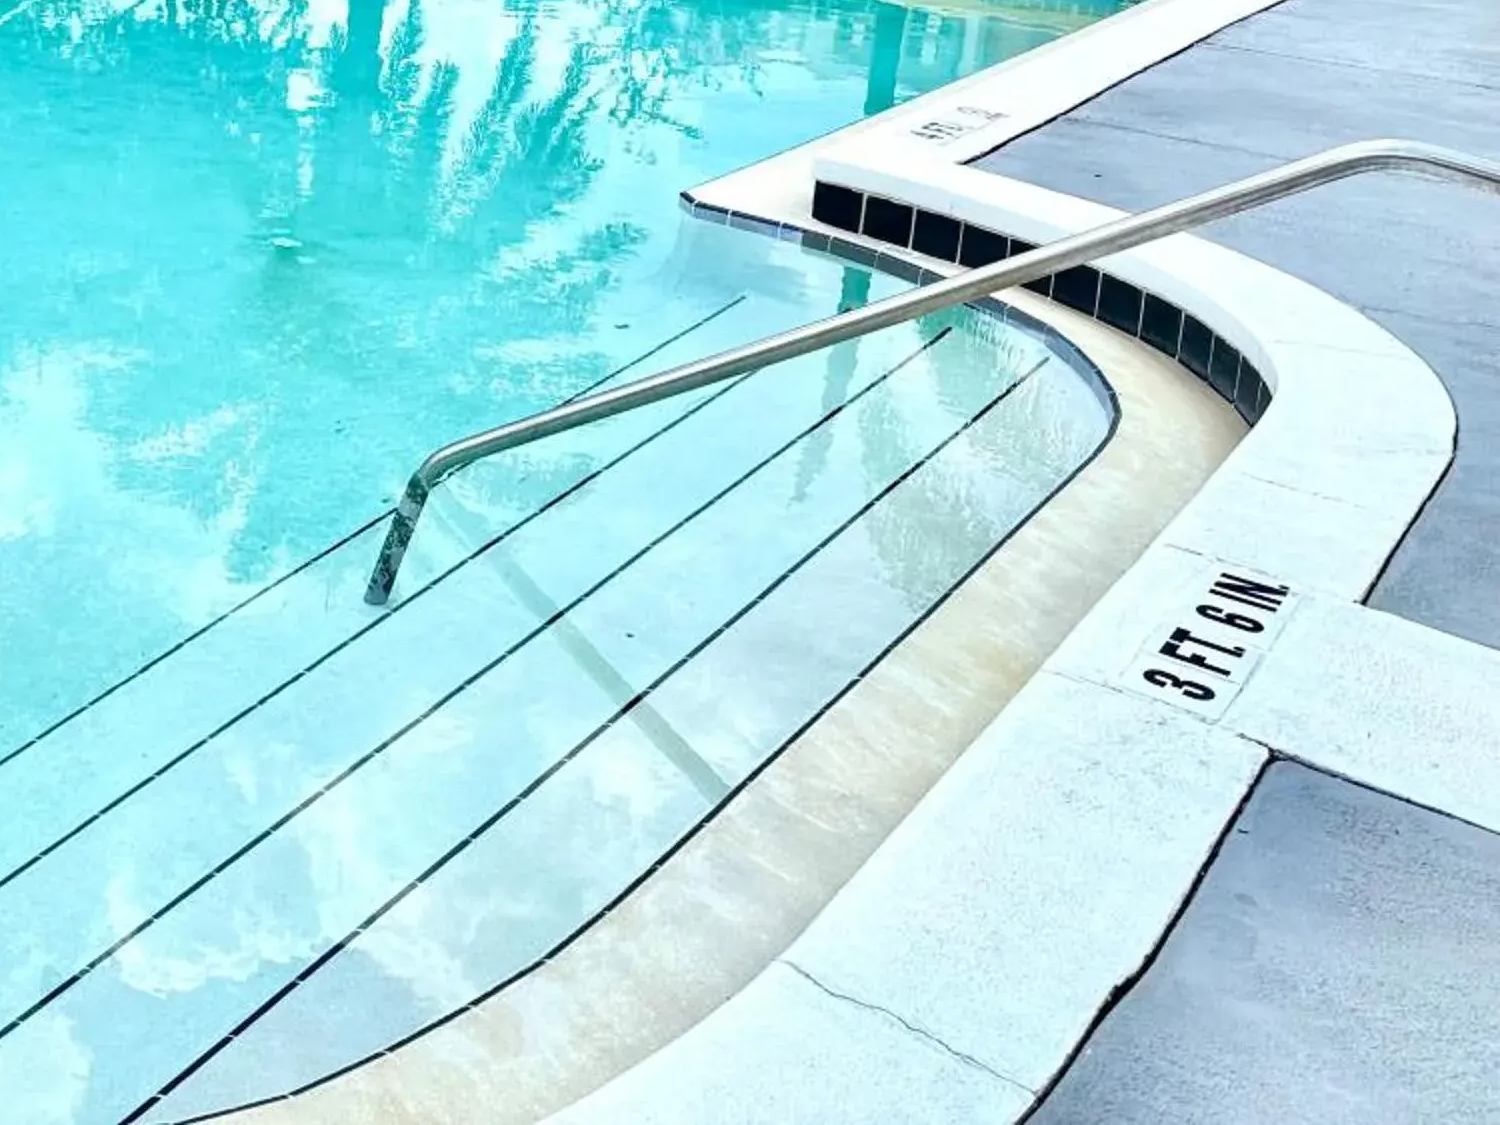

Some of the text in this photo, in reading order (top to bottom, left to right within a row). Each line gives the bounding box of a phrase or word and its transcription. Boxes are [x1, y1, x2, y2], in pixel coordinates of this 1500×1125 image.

[1142, 572, 1290, 701] 3 FT. 6 IN.
